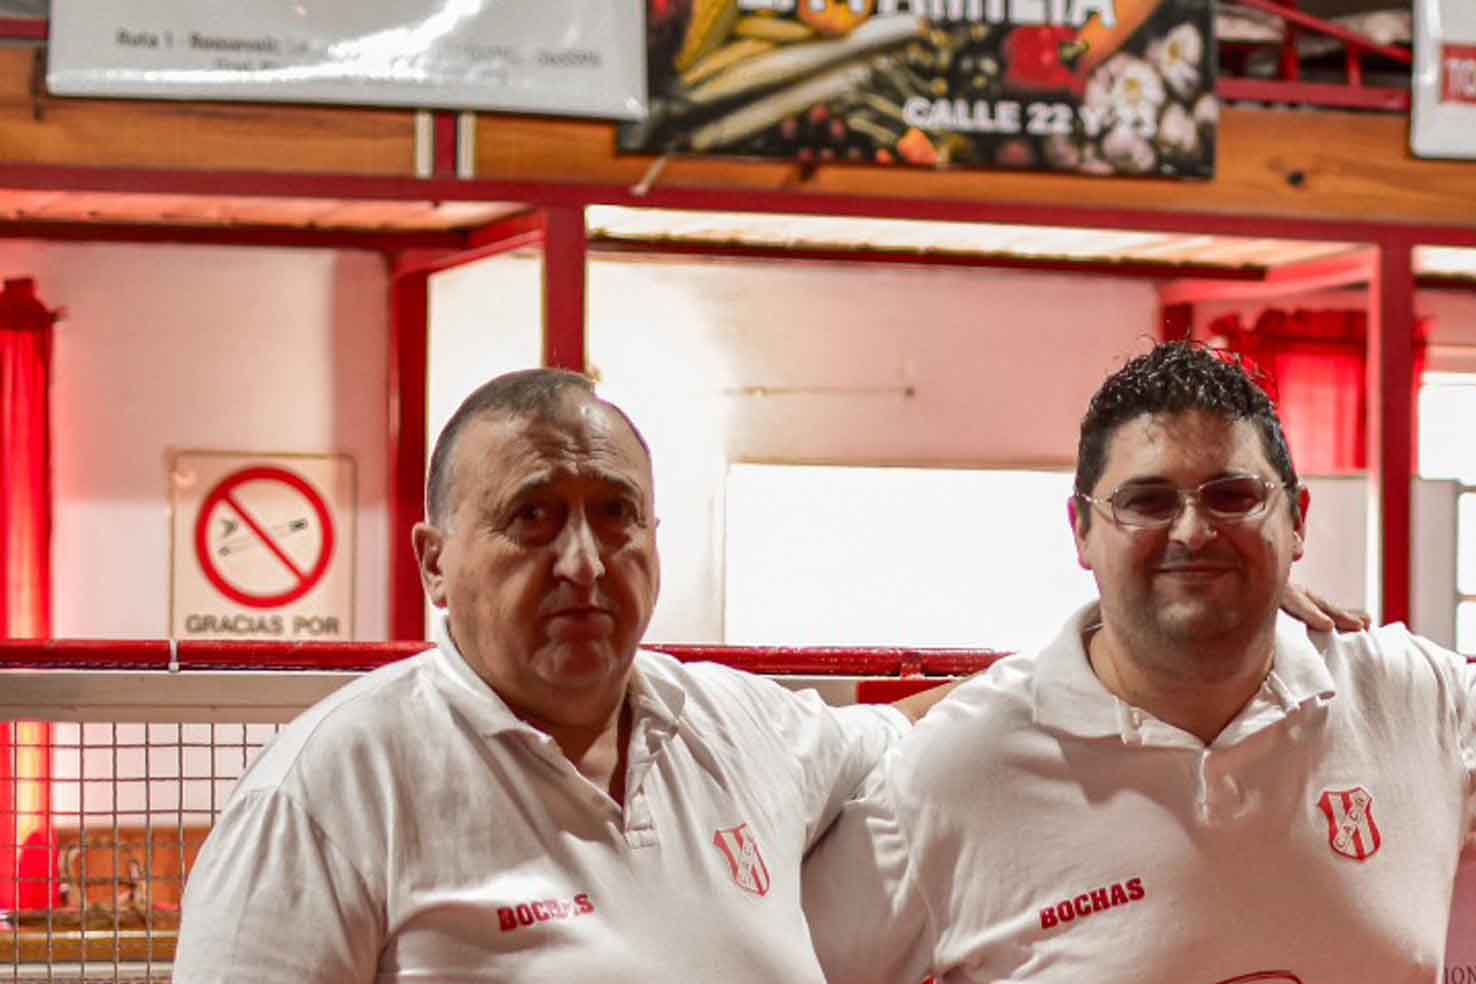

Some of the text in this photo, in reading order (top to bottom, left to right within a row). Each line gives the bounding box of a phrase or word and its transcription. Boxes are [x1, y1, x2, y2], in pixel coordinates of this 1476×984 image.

[902, 97, 1021, 133] CALLE
[1025, 102, 1074, 136] 22
[185, 615, 339, 636] GRACIAS POR
[498, 893, 594, 932] BOCHS
[1040, 878, 1146, 930] BOCHAS
